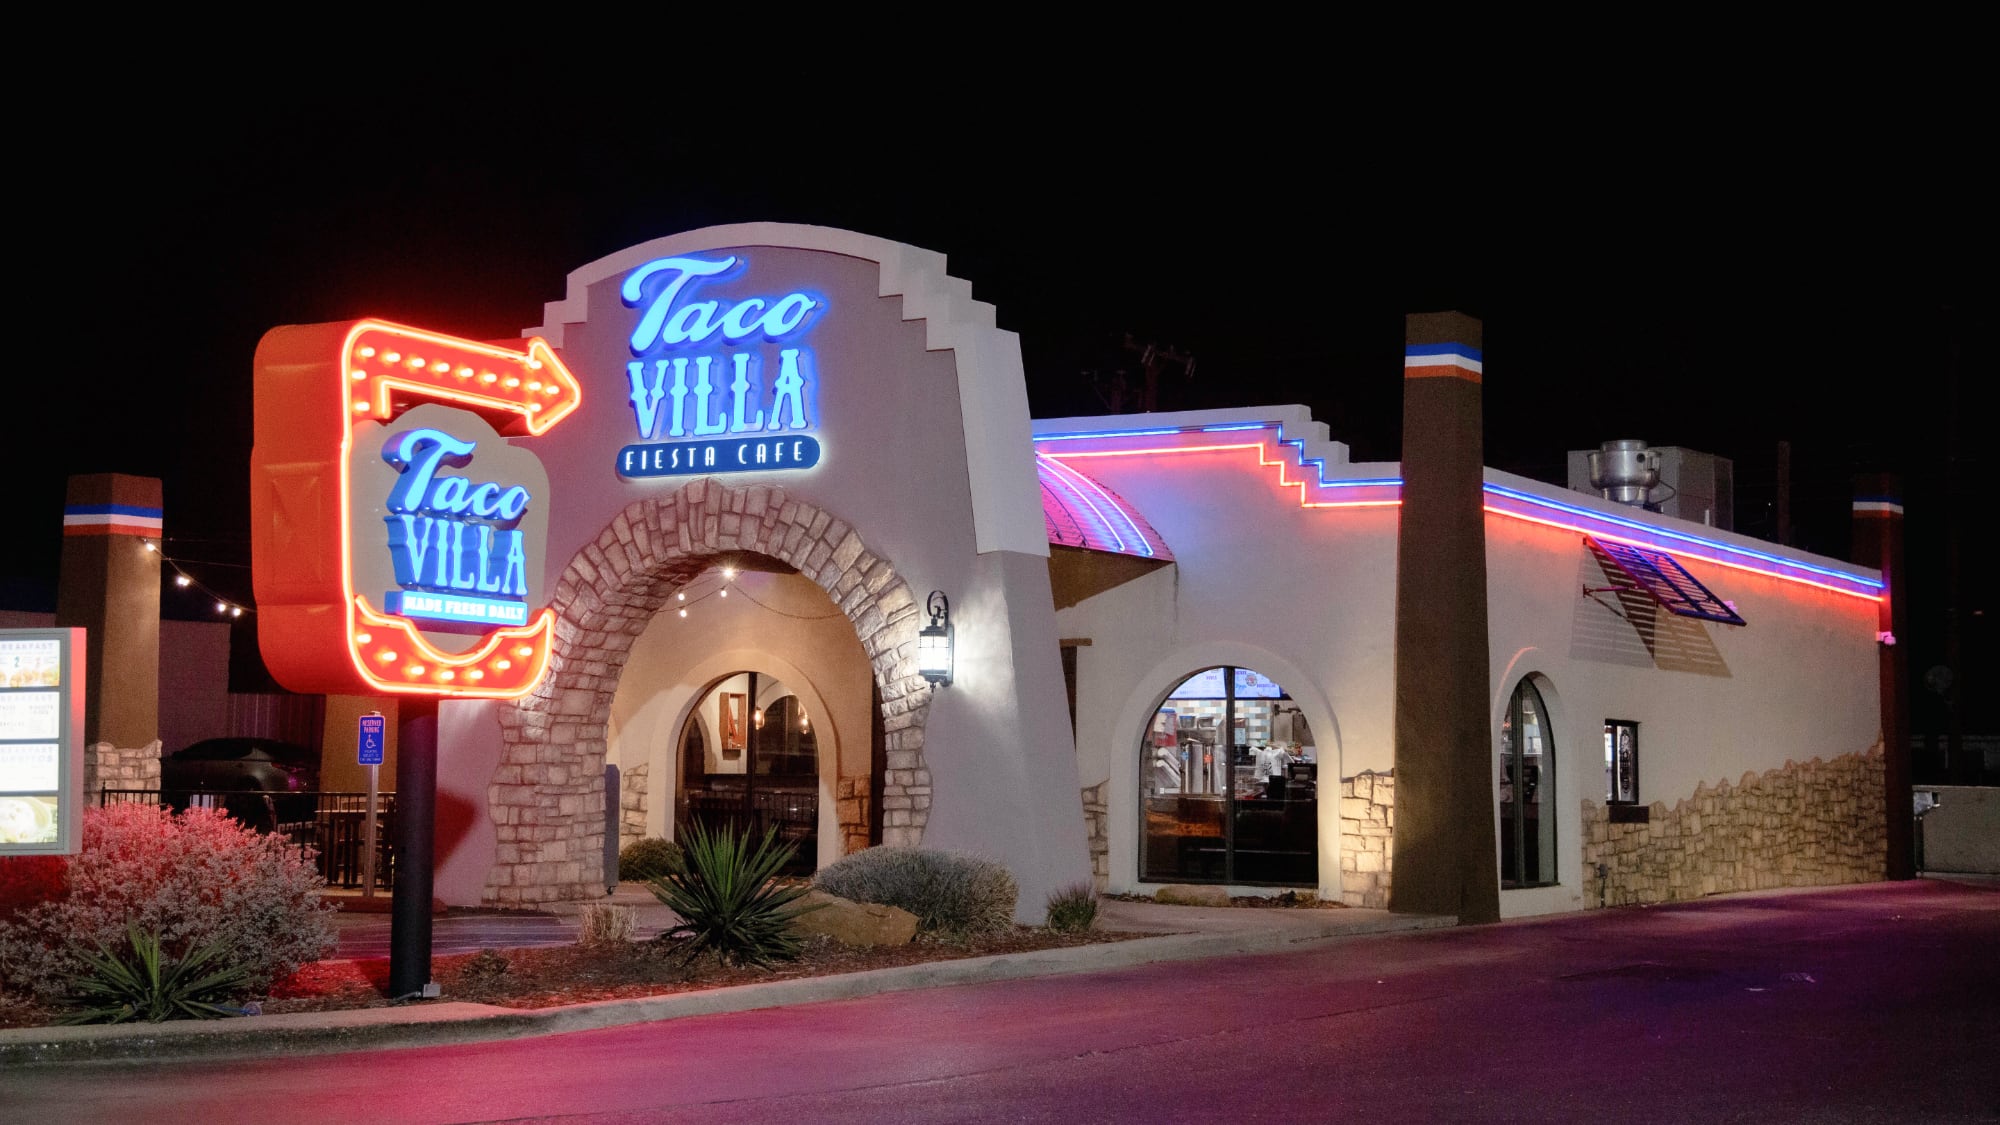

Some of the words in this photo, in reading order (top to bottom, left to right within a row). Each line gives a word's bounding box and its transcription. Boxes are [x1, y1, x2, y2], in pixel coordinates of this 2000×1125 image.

[621, 255, 817, 353] Taco
[627, 348, 809, 439] VILLA
[396, 428, 531, 520] Taco
[625, 446, 715, 471] FIESTA
[738, 441, 803, 465] CAFE
[398, 514, 528, 596] VILLA
[404, 596, 443, 613] MADE
[445, 600, 486, 617] FRESH
[488, 604, 524, 620] DAILY
